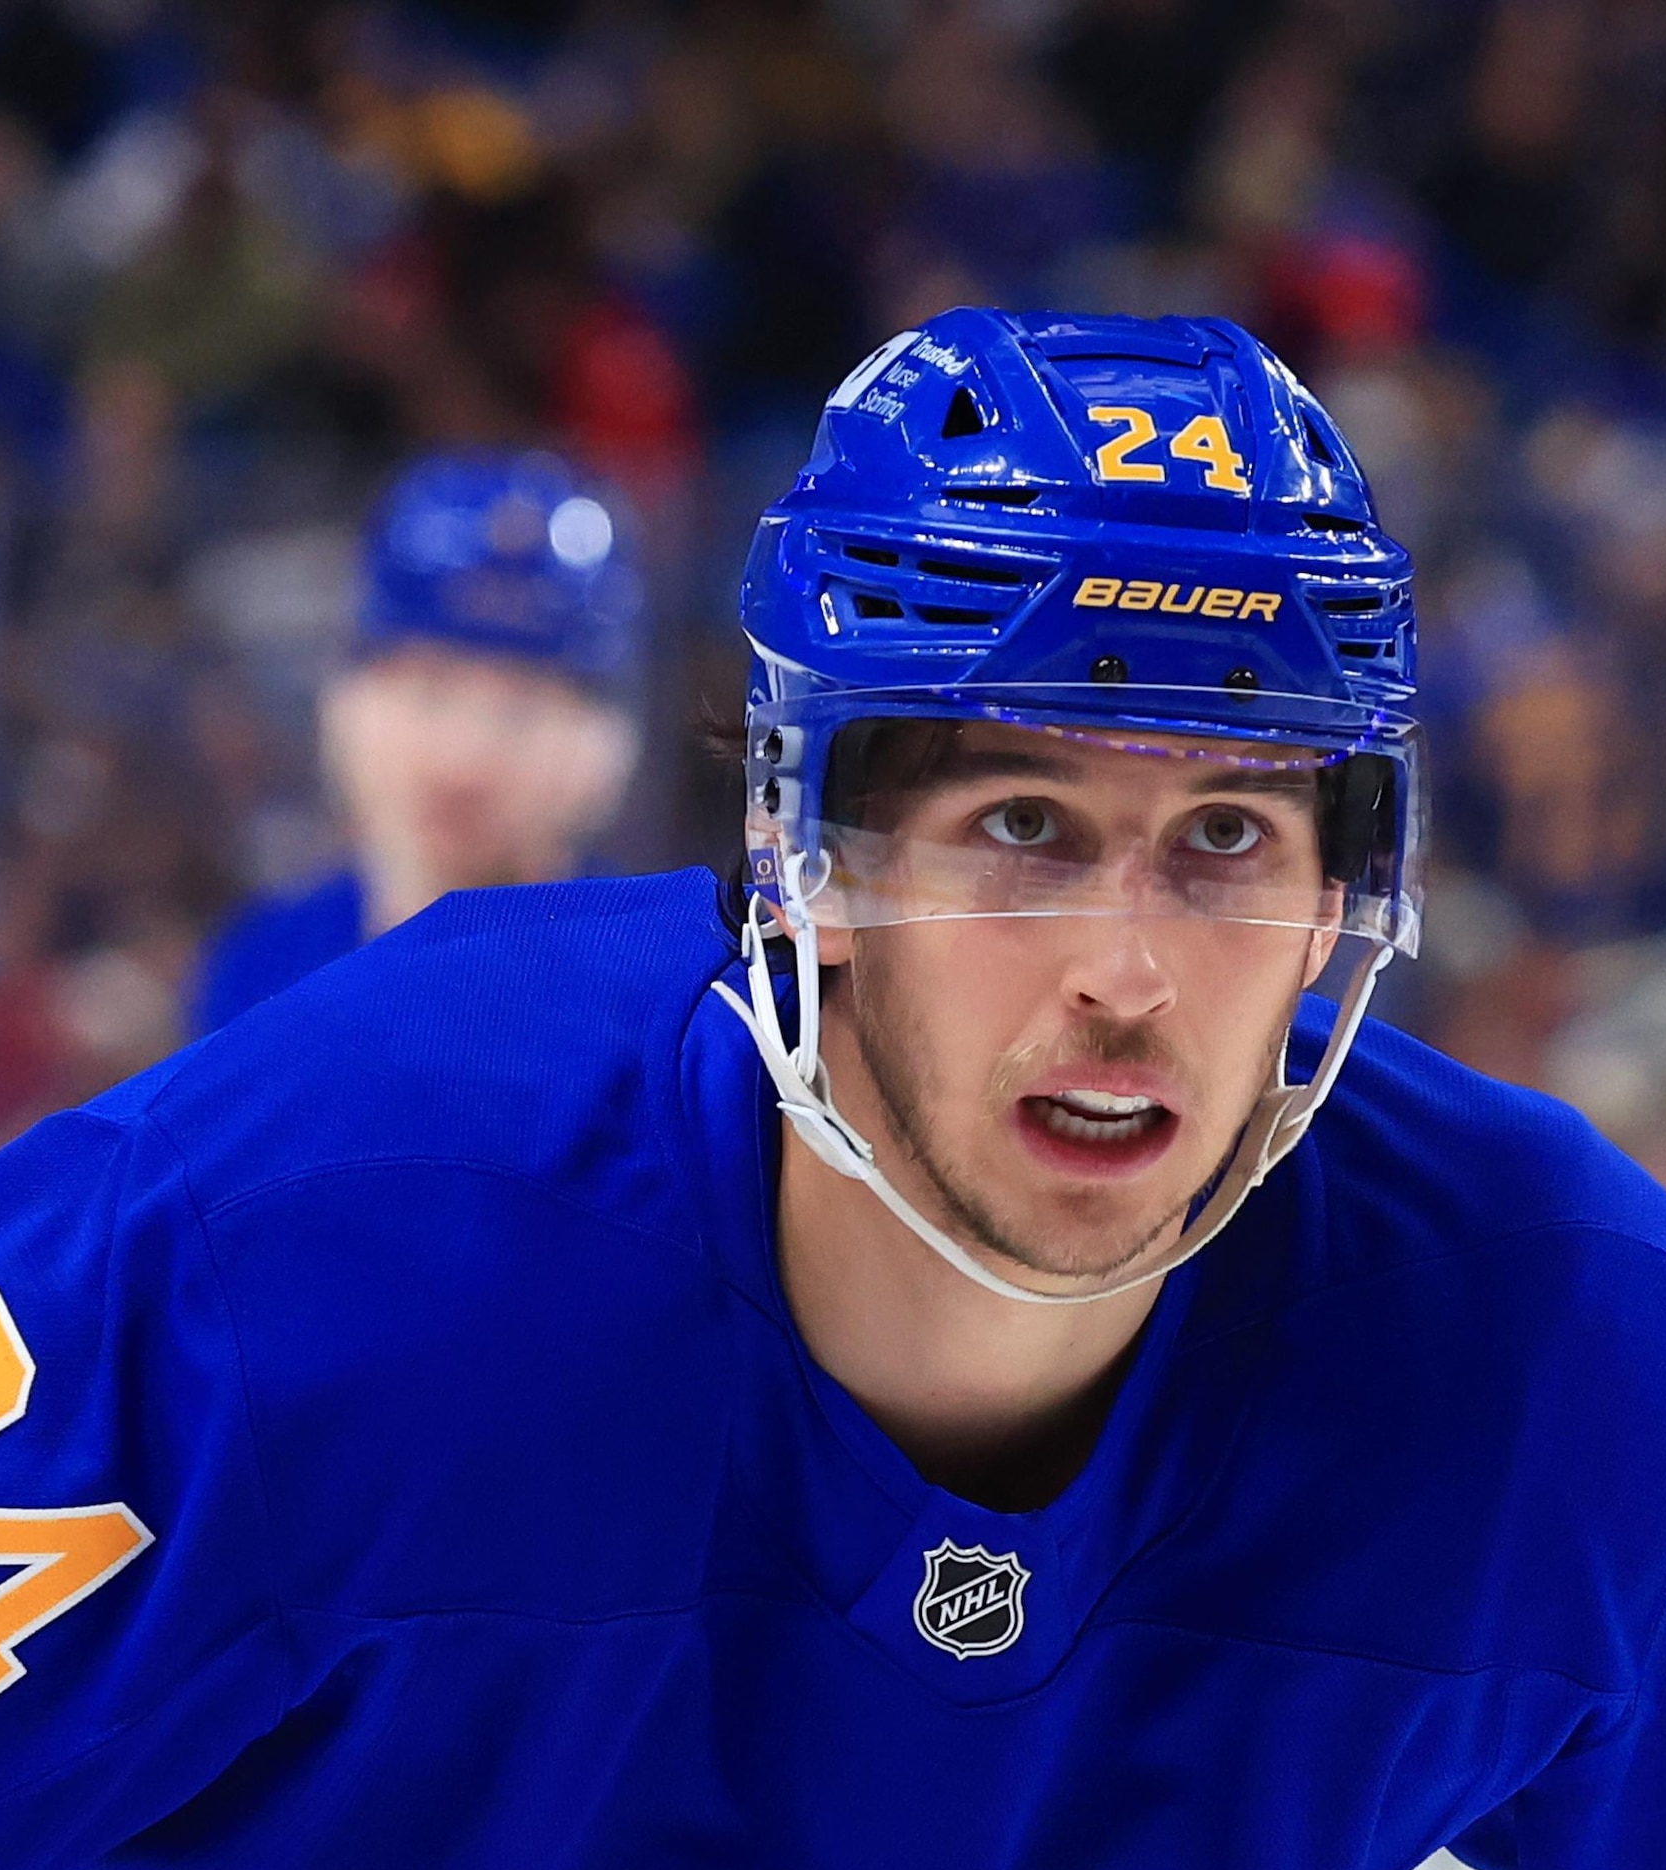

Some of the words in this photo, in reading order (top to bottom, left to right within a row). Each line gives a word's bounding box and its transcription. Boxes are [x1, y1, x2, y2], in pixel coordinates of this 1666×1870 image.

[880, 359, 921, 389] Nurse
[909, 334, 973, 376] Trusted
[857, 386, 906, 425] Staffing
[1086, 406, 1250, 494] 24
[1073, 576, 1282, 623] BAUER
[937, 1577, 1006, 1629] NHL
